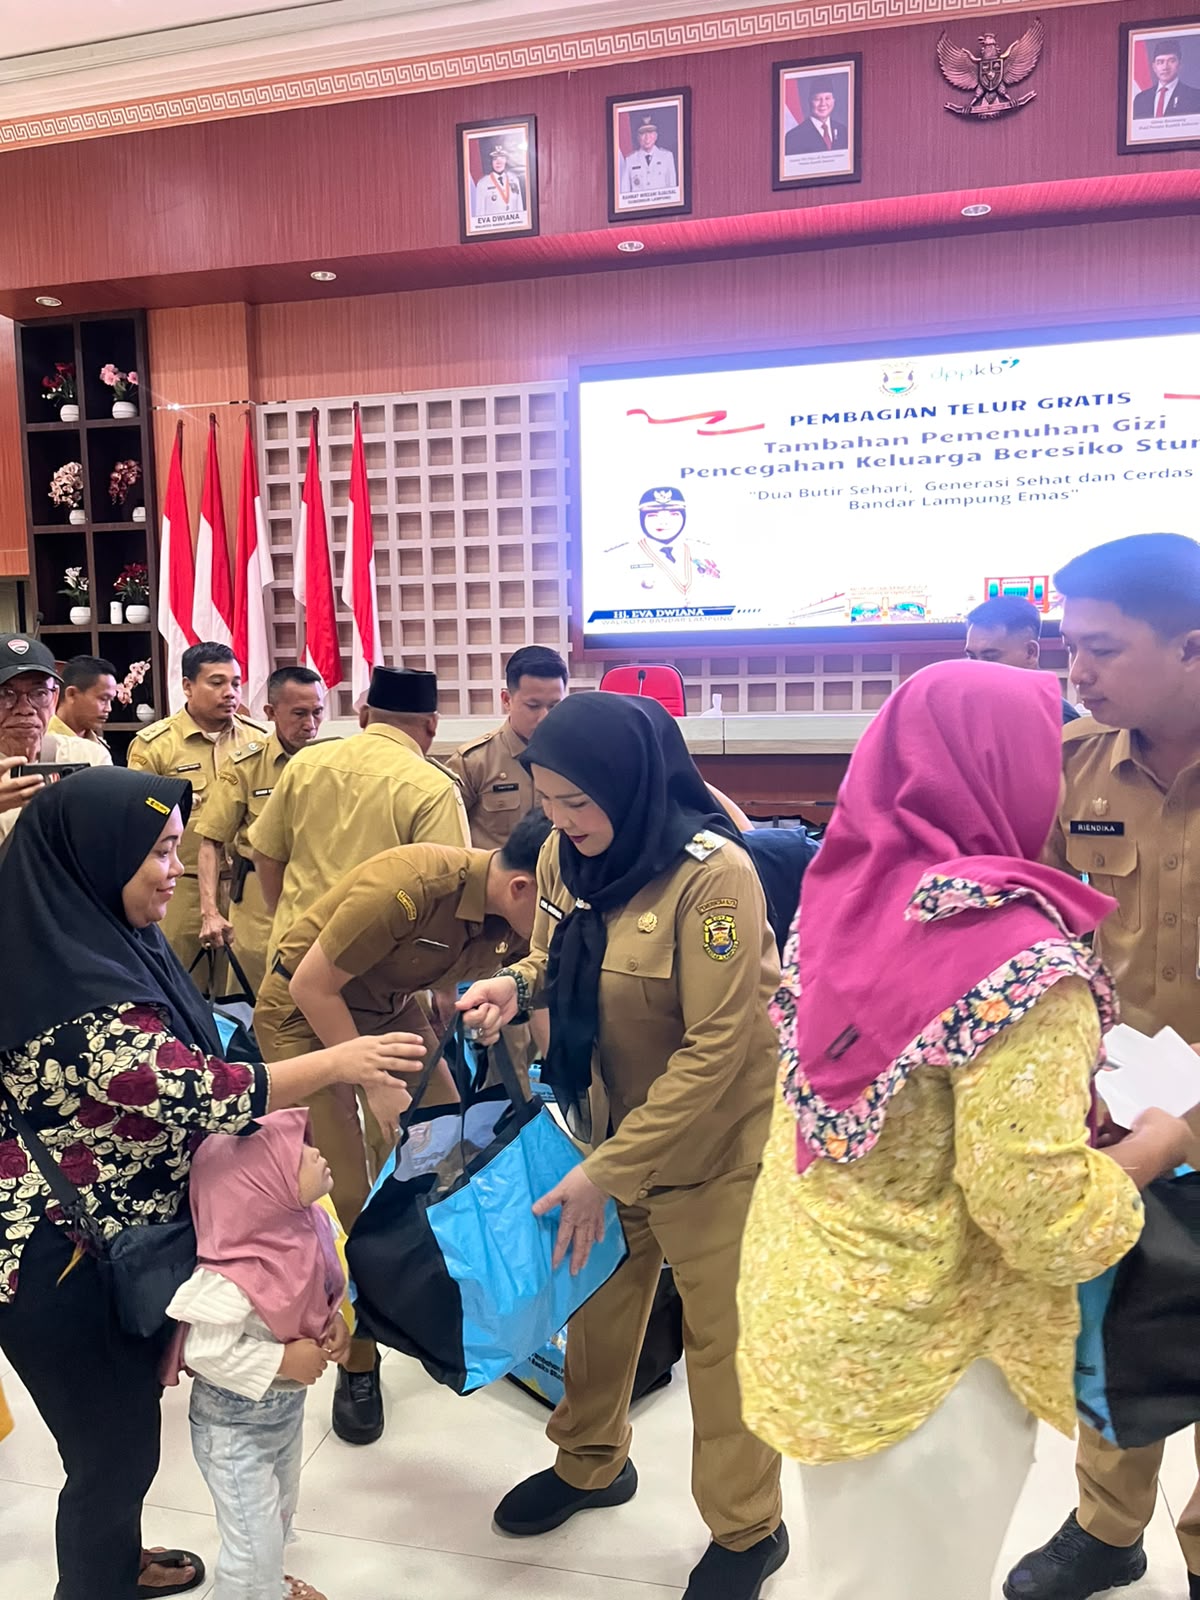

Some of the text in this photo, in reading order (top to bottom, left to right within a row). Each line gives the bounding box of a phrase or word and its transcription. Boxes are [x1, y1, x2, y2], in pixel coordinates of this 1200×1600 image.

[477, 213, 520, 224] EVA DWIANA
[790, 392, 1131, 426] PEMBAGIAN TELUR GRATIS
[764, 415, 1166, 454] Tambahan Pemenuhan Gizi
[680, 459, 845, 479] Pencegahan
[857, 452, 981, 469] Keluarga
[994, 441, 1123, 460] Beresiko
[749, 468, 1193, 500] "Dua Butir Sehari, Generasi Sehat dan Cerdas
[849, 489, 1078, 510] Bandar Lampung Emas"
[632, 609, 654, 618] EVA
[655, 607, 705, 617] DWIANA
[1078, 823, 1116, 832] RIENDIKA
